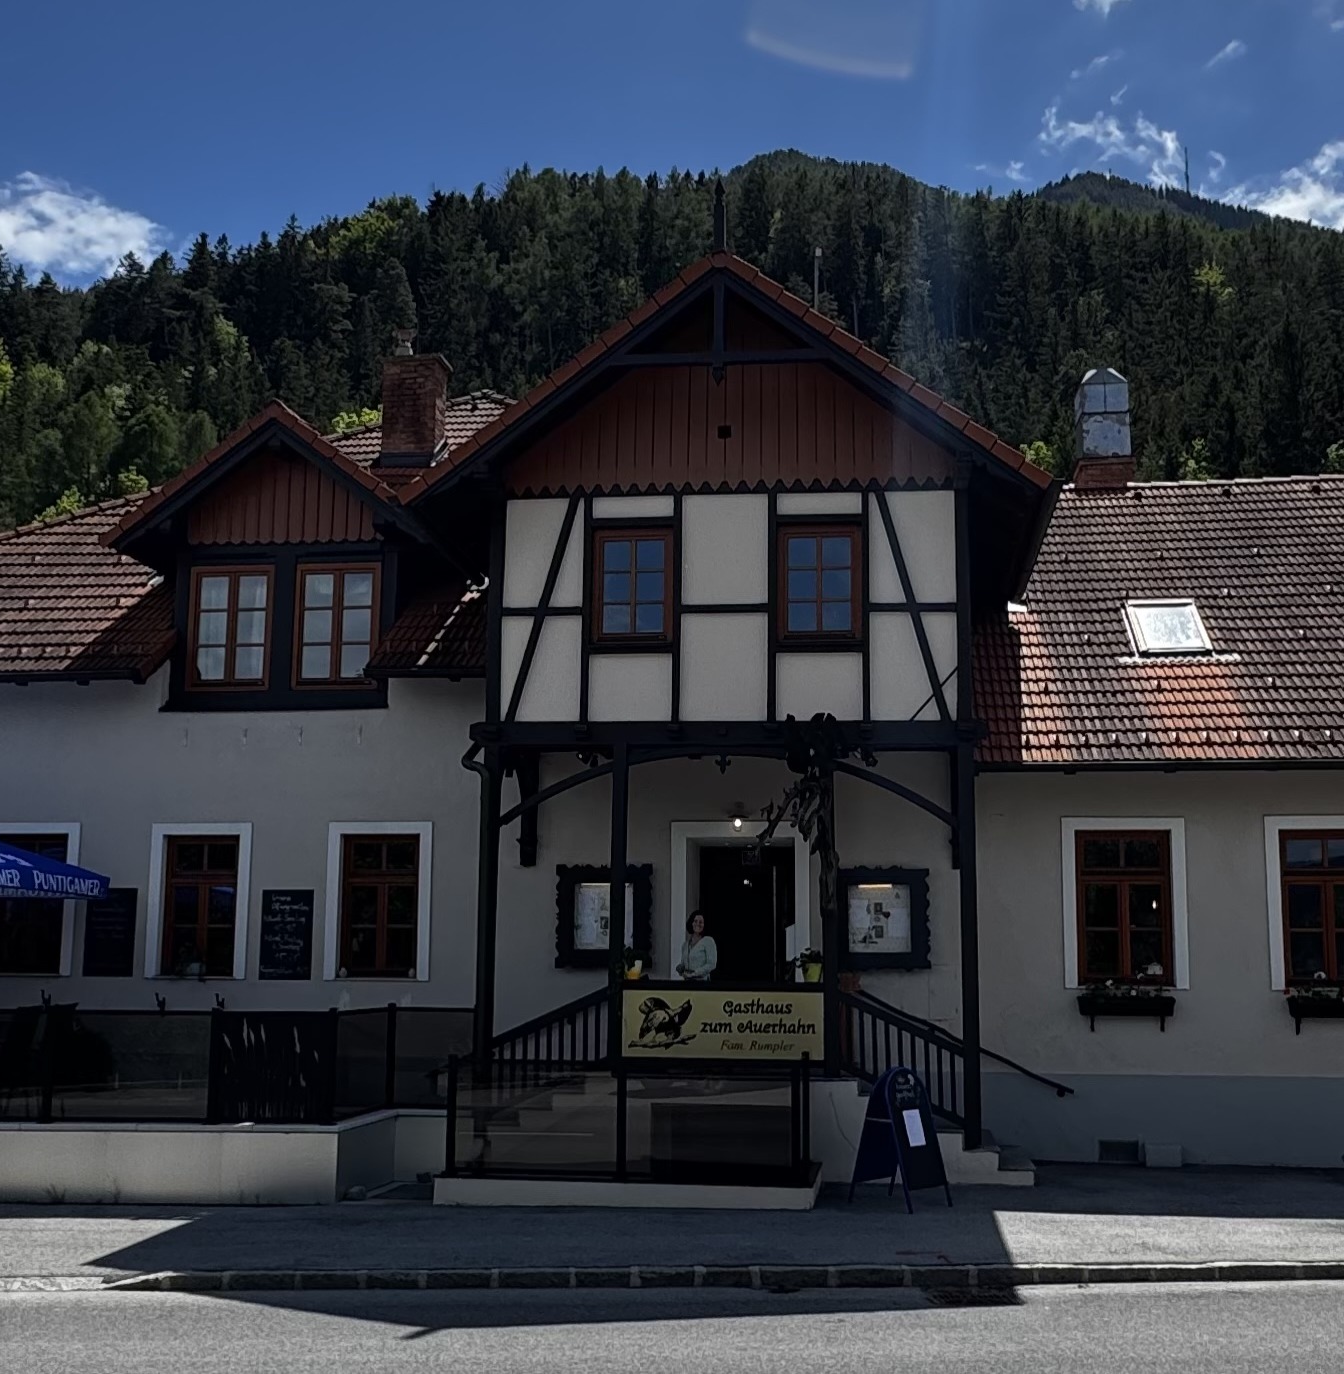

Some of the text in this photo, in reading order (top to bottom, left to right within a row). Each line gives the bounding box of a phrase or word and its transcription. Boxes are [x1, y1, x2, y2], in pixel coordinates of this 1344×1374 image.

[31, 869, 101, 897] PUNTIGAMER
[722, 997, 793, 1017] Gasthaus
[700, 1018, 816, 1035] zum Auerhahn
[720, 1039, 795, 1053] Fam. Rumpler
